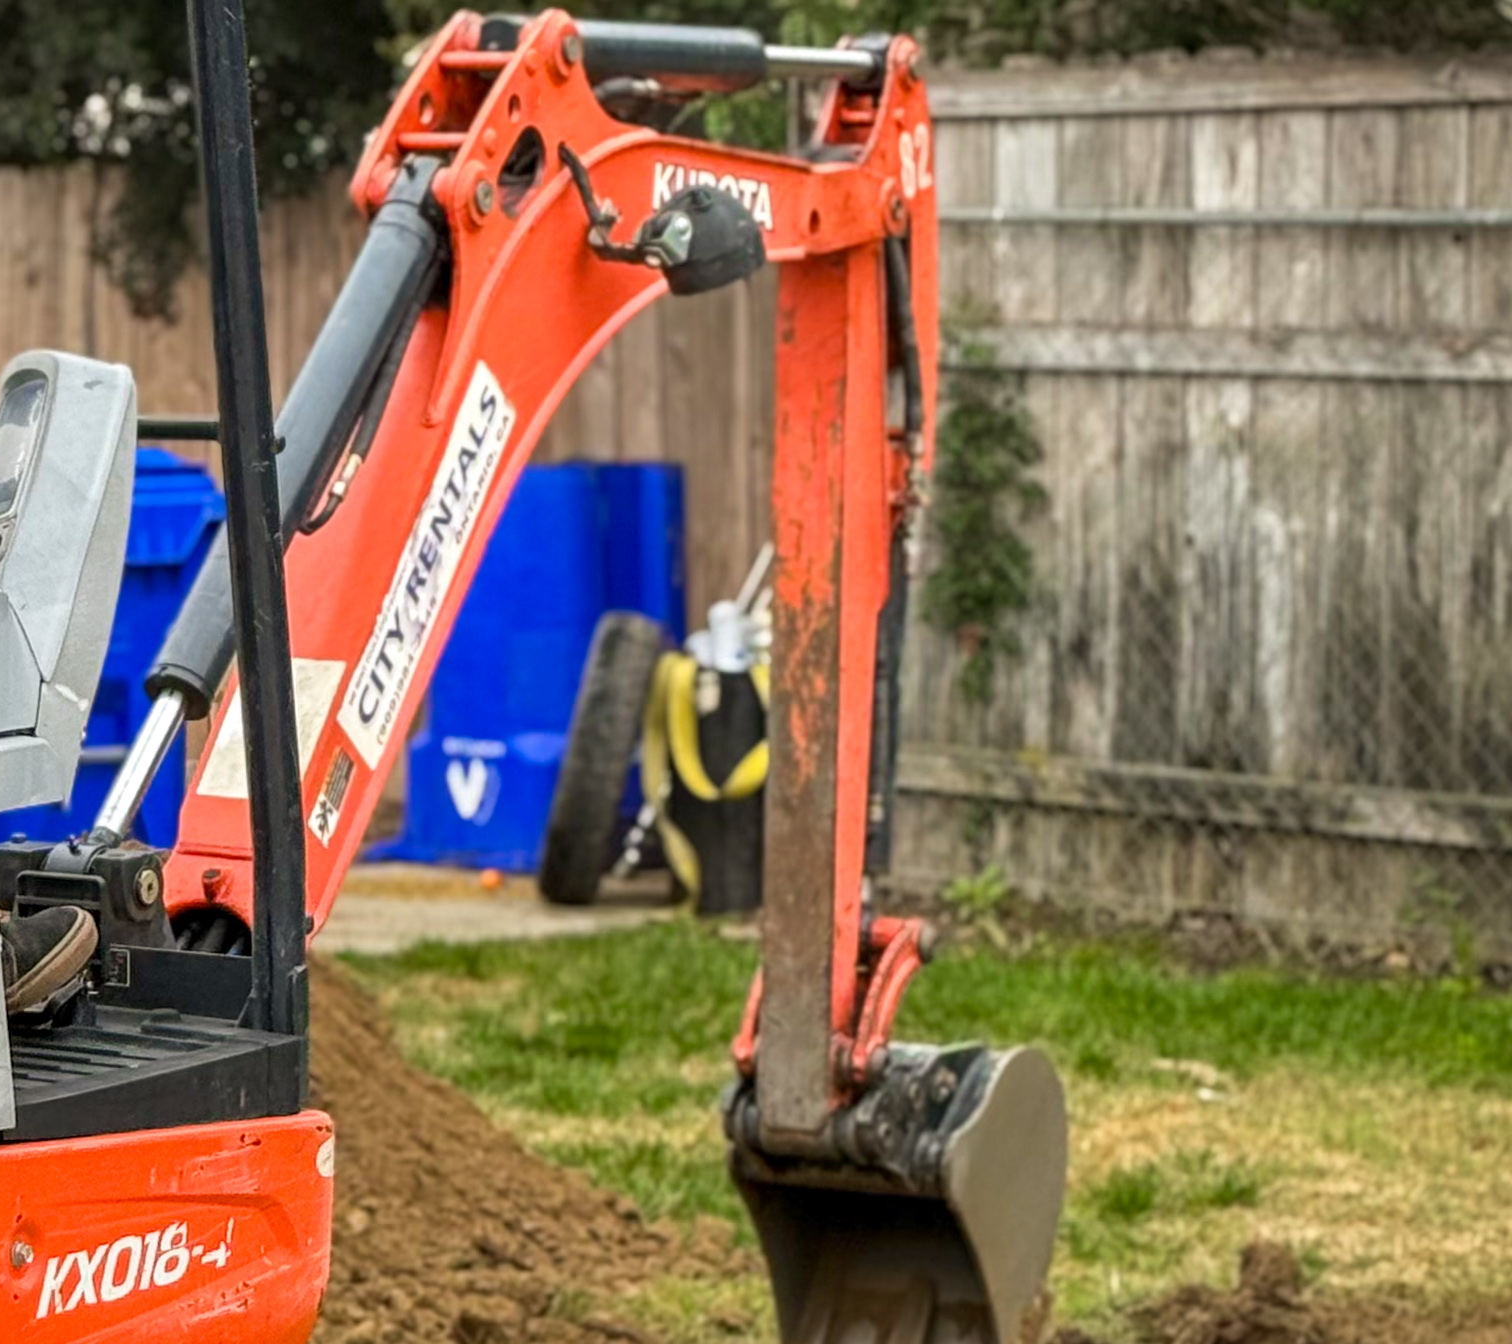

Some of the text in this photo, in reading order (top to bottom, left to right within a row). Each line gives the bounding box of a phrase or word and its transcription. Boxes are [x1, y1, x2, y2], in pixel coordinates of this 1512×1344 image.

[899, 122, 933, 199] 82
[494, 413, 510, 443] CA
[357, 384, 498, 726] CITY RENTALS
